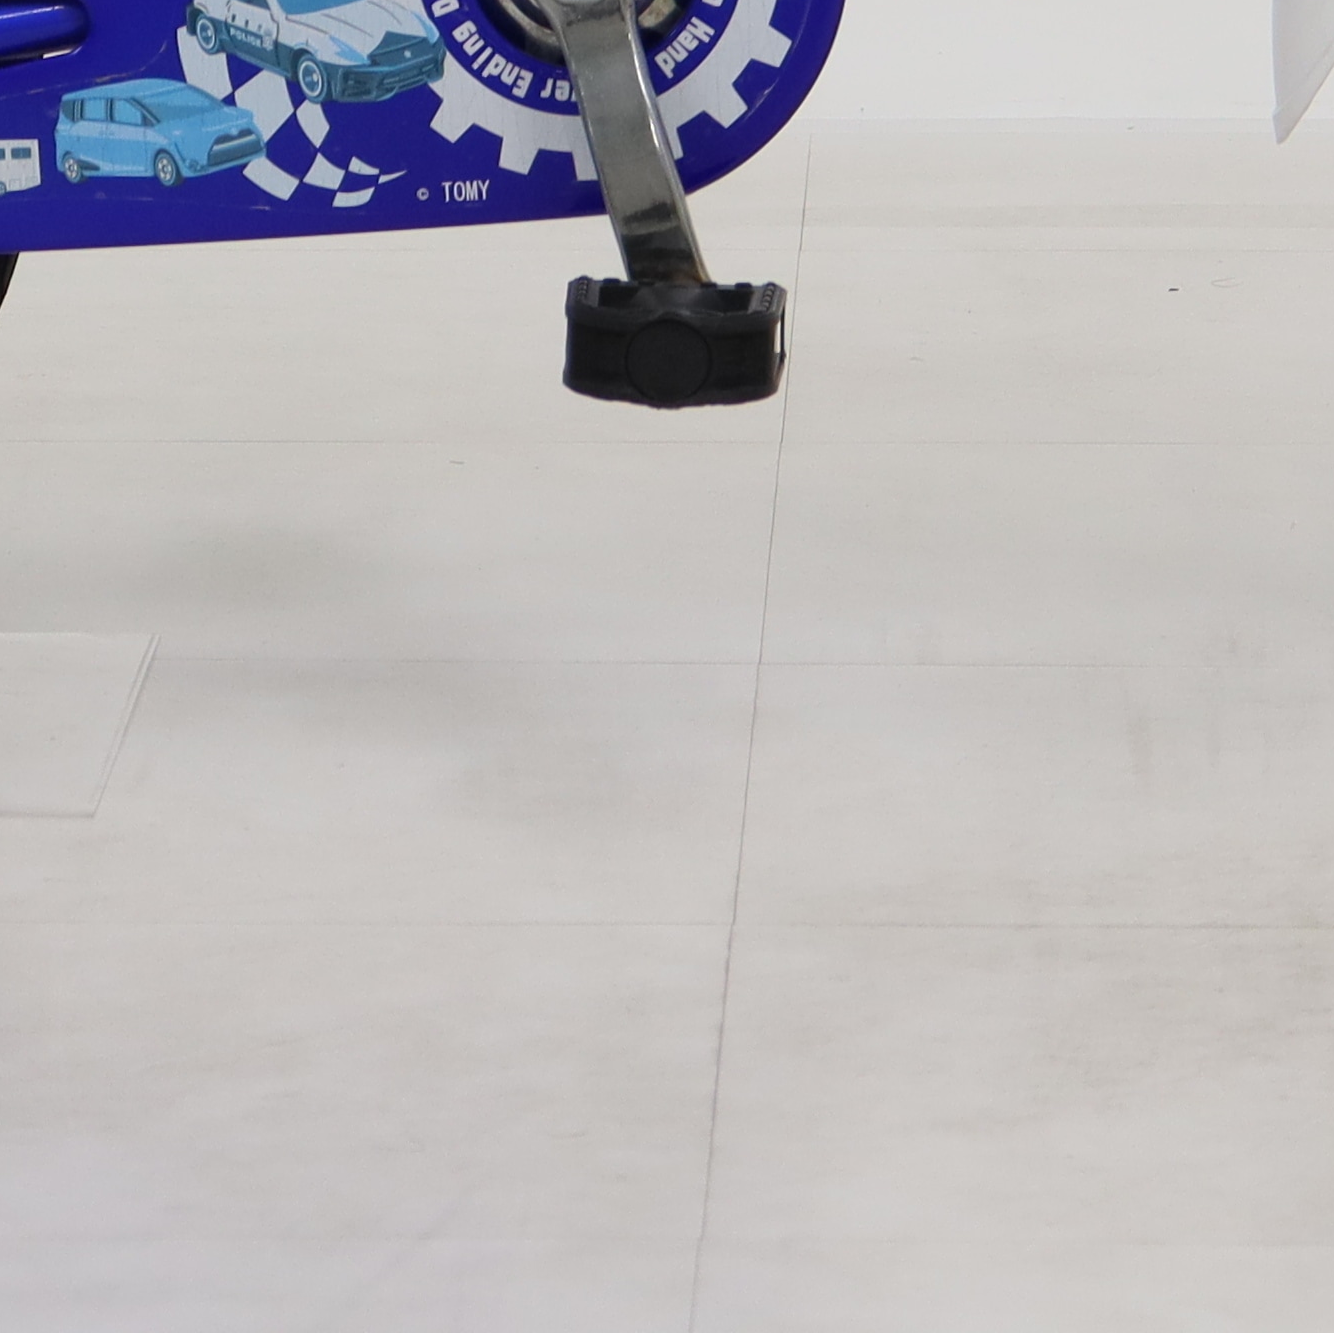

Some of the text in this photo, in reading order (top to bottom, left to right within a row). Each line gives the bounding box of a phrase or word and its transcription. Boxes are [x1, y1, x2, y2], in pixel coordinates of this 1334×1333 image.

[452, 20, 533, 99] Ending
[654, 16, 715, 79] Hand
[441, 179, 490, 203] TOMY
